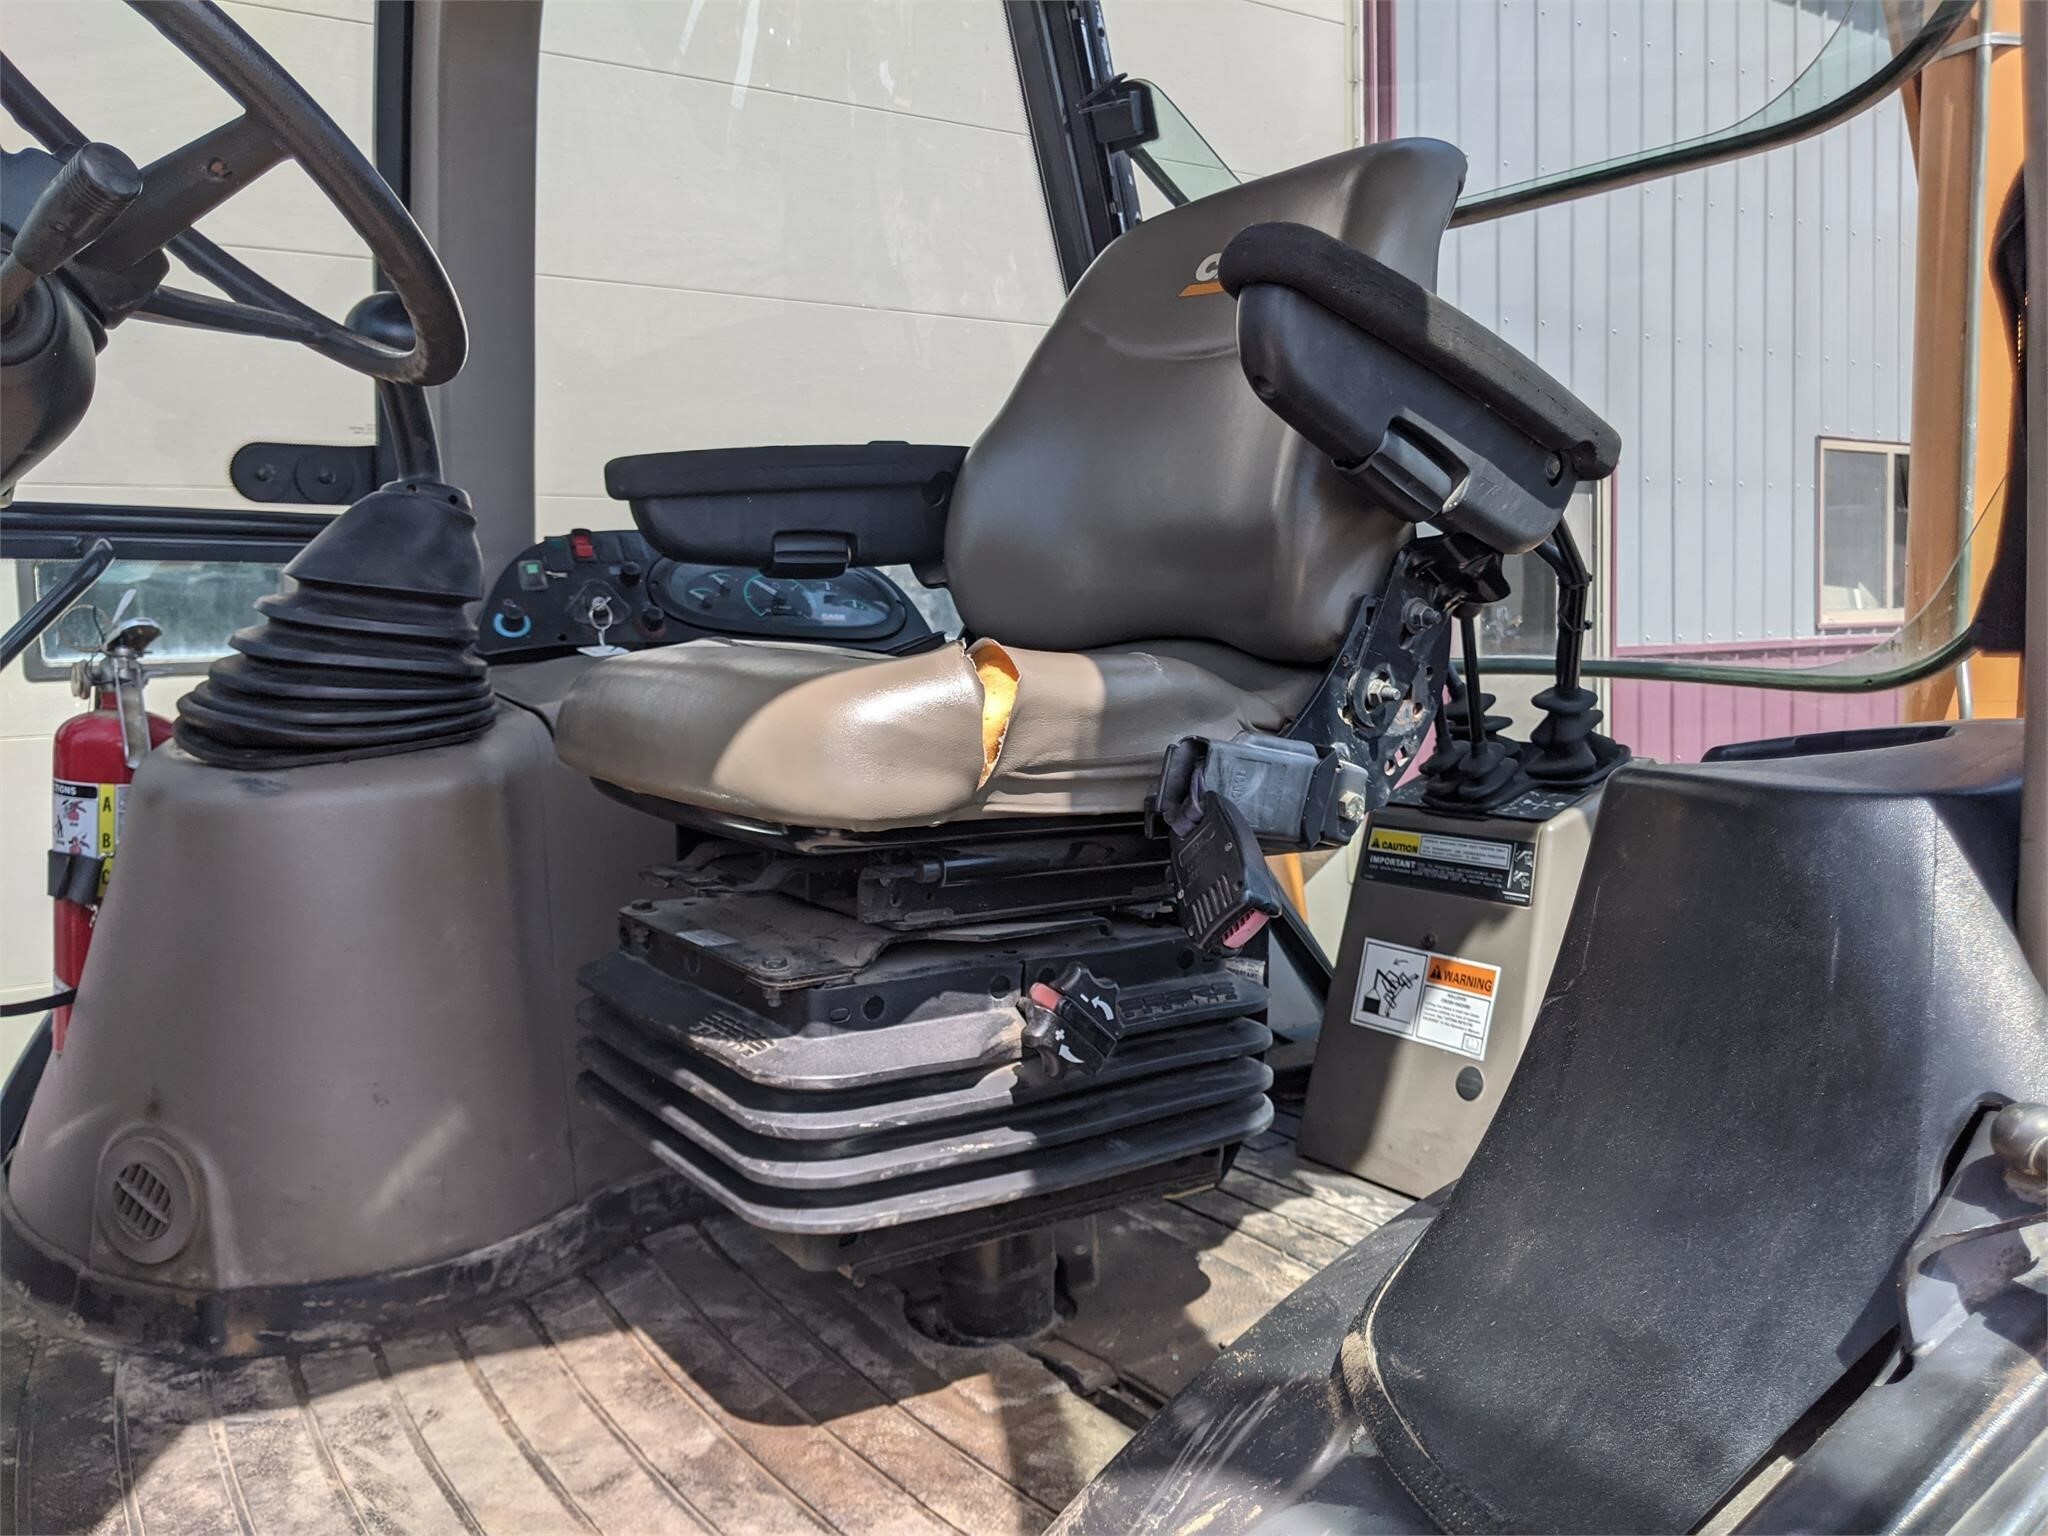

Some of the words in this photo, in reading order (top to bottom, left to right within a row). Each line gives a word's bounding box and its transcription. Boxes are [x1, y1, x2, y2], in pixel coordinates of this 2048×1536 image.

[102, 796, 112, 812] A
[102, 833, 111, 848] B
[1382, 841, 1418, 853] CAUTION
[1370, 855, 1416, 868] IMPORTANT
[1444, 970, 1493, 992] WARNING
